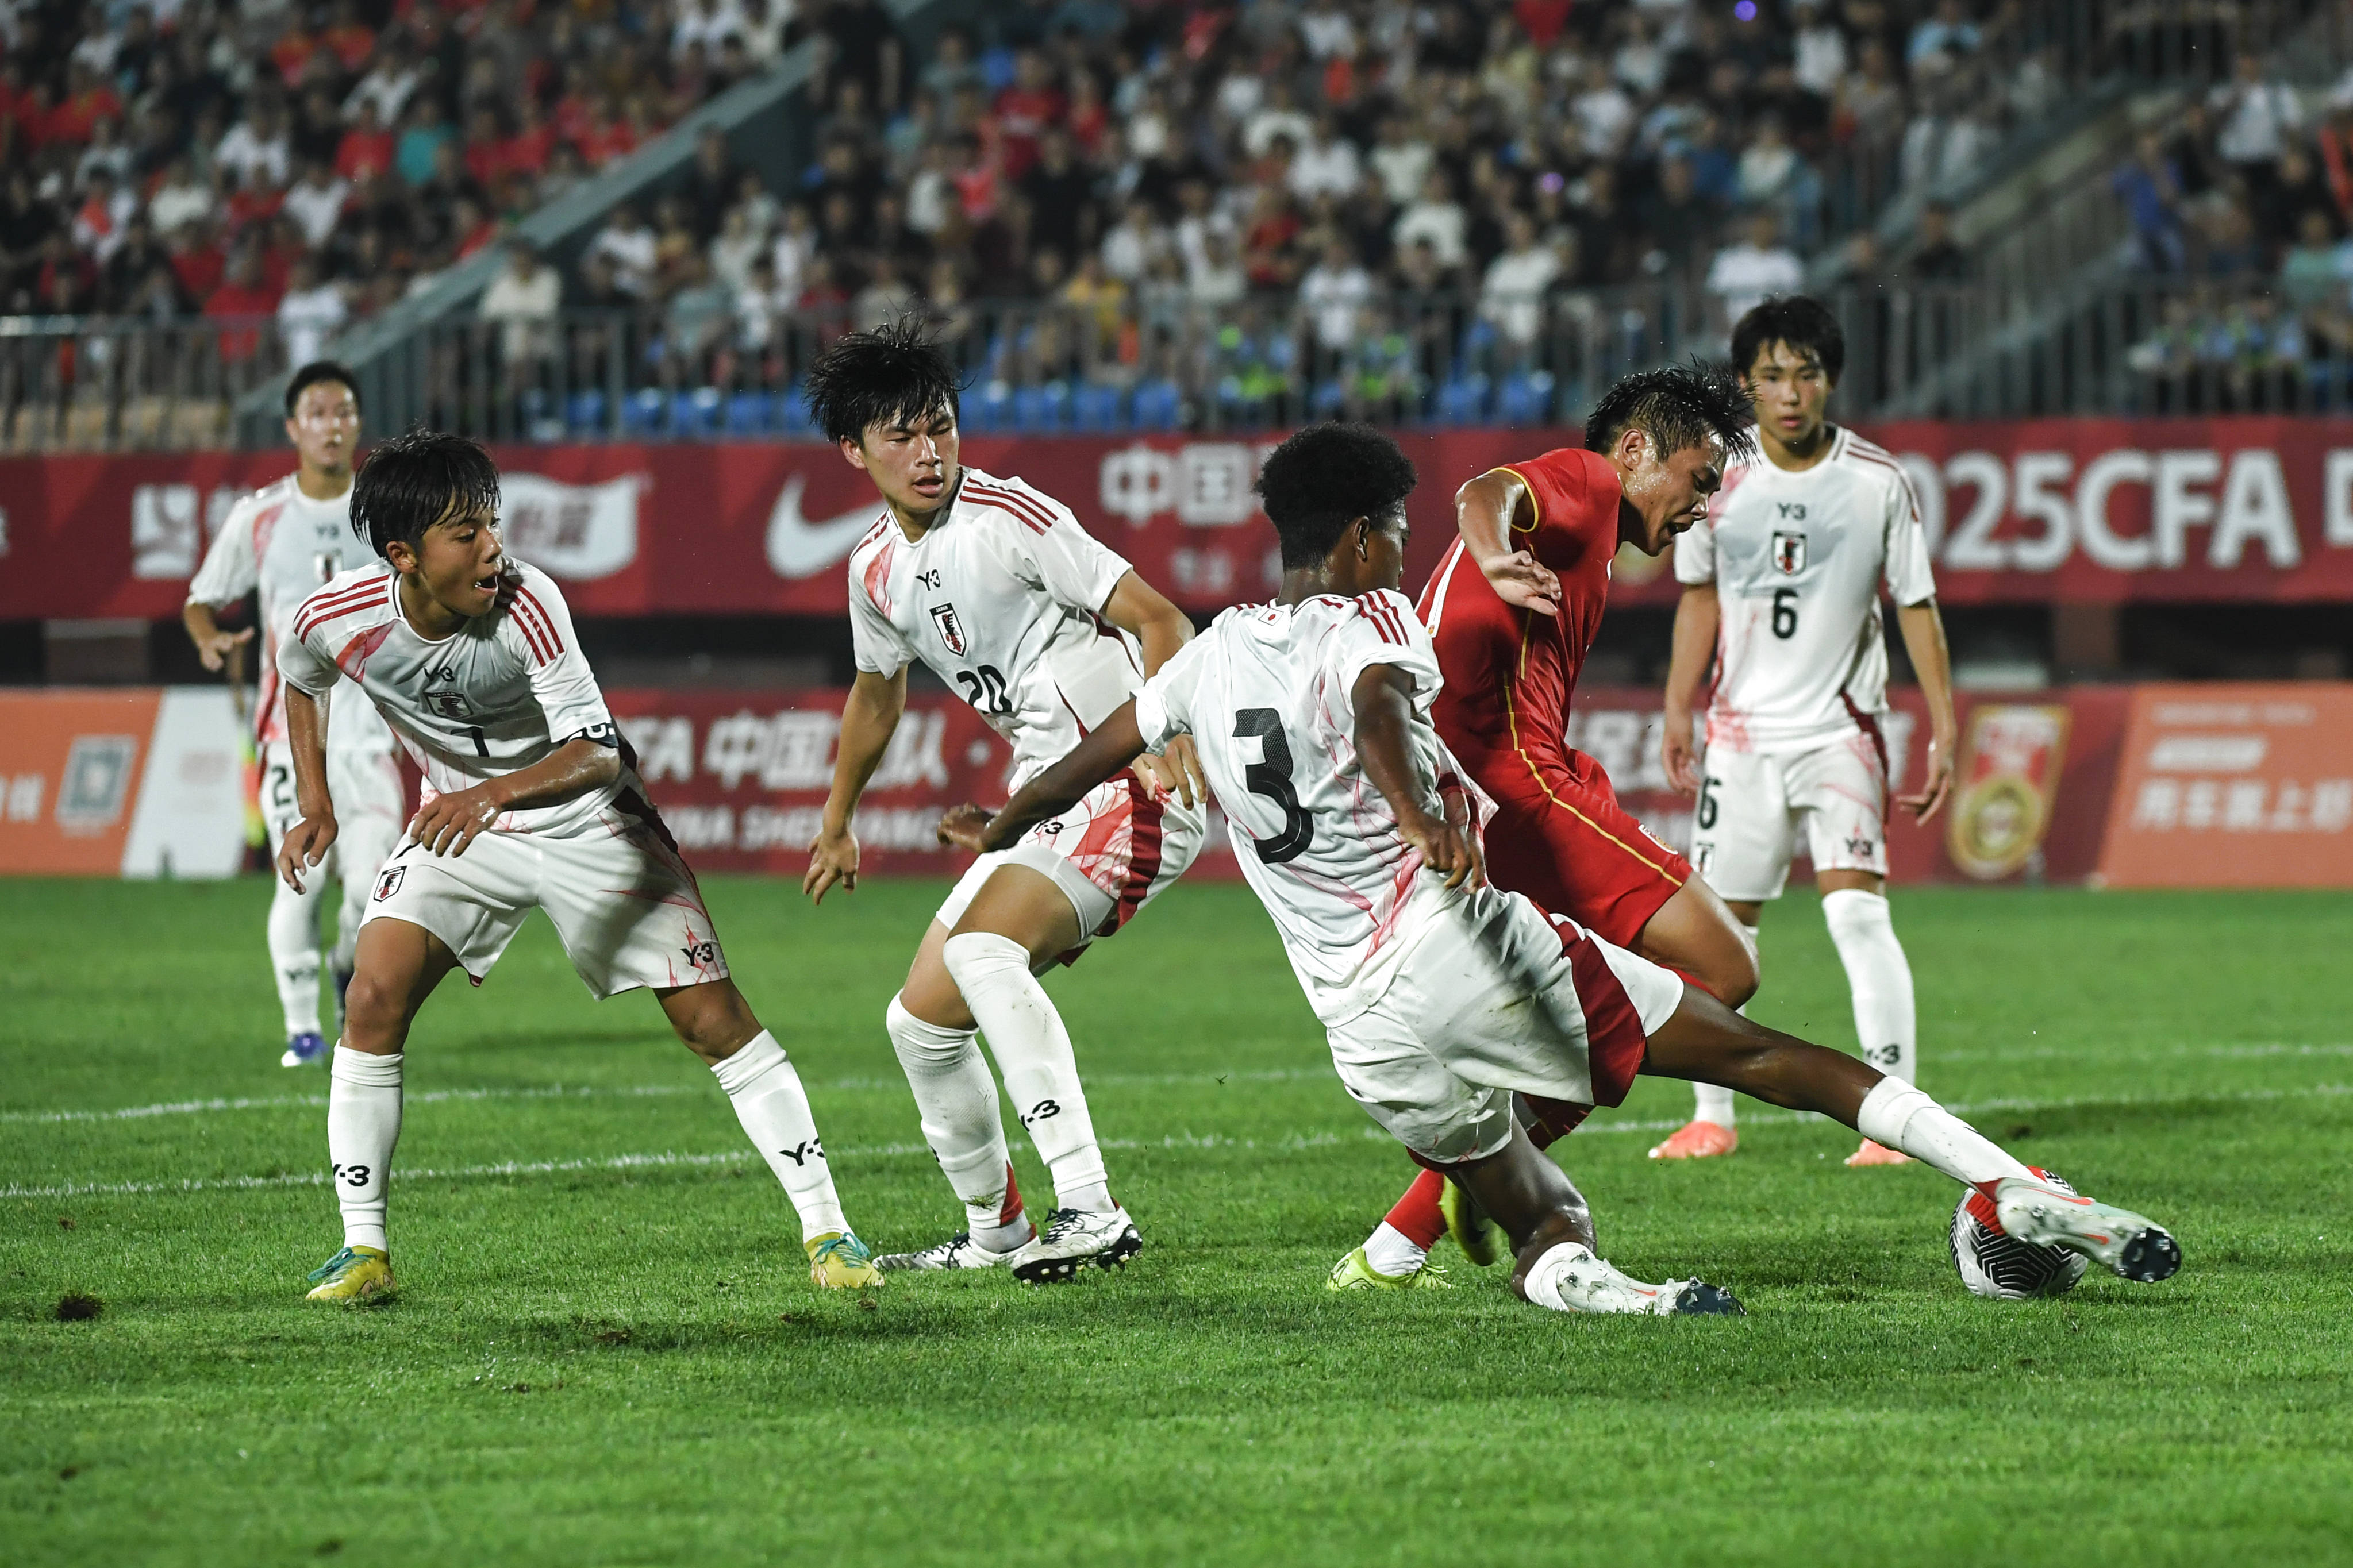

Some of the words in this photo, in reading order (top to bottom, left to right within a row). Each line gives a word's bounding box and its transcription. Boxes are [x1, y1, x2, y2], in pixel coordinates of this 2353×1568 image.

[1099, 441, 1277, 527] 中国
[1773, 588, 1798, 639] 6
[956, 664, 1013, 714] 20
[450, 726, 490, 757] 7
[1232, 708, 1314, 864] 3
[1699, 777, 1723, 830] 6
[680, 943, 714, 966] Y-3
